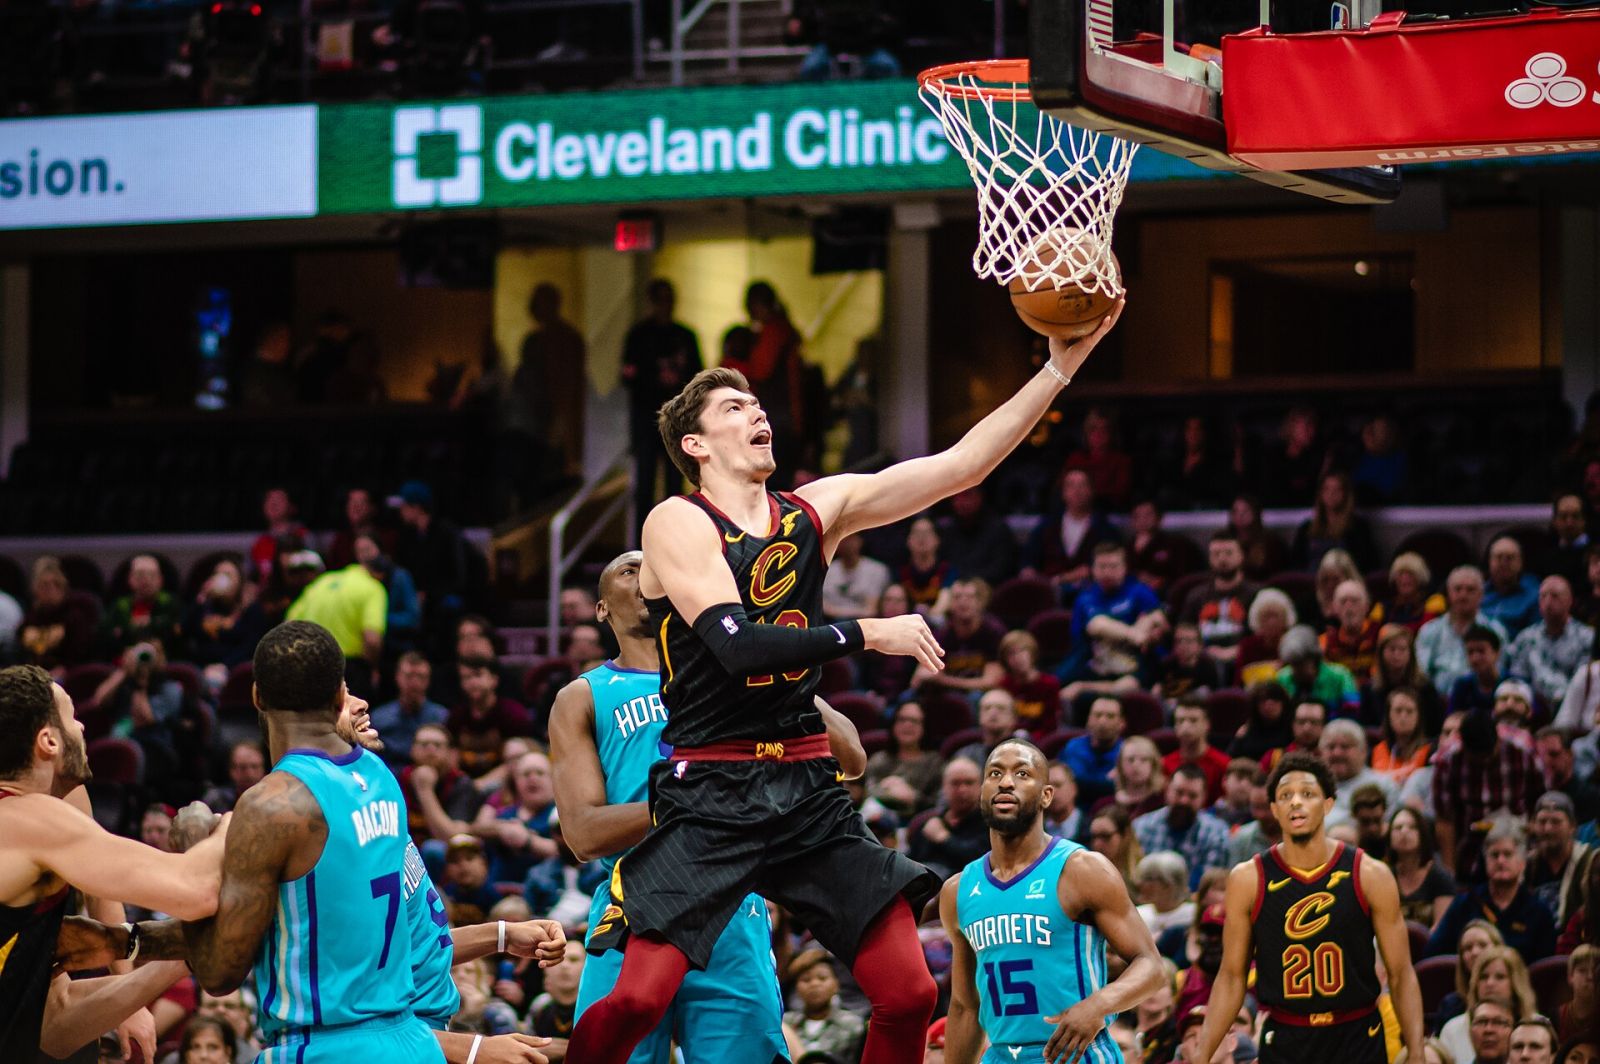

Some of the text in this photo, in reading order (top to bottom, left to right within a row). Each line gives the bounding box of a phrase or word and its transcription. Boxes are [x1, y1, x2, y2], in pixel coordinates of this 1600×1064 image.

[495, 106, 948, 181] Cleveland Clinic
[1377, 148, 1510, 161] Farm
[0, 148, 124, 198] sion.
[751, 541, 798, 606] C
[755, 741, 785, 759] CAVS
[351, 800, 399, 848] BACON
[370, 870, 400, 970] 7
[964, 913, 1053, 952] HORNETS
[1284, 891, 1336, 940] C
[983, 958, 1039, 1017] 15
[1282, 941, 1344, 999] 20
